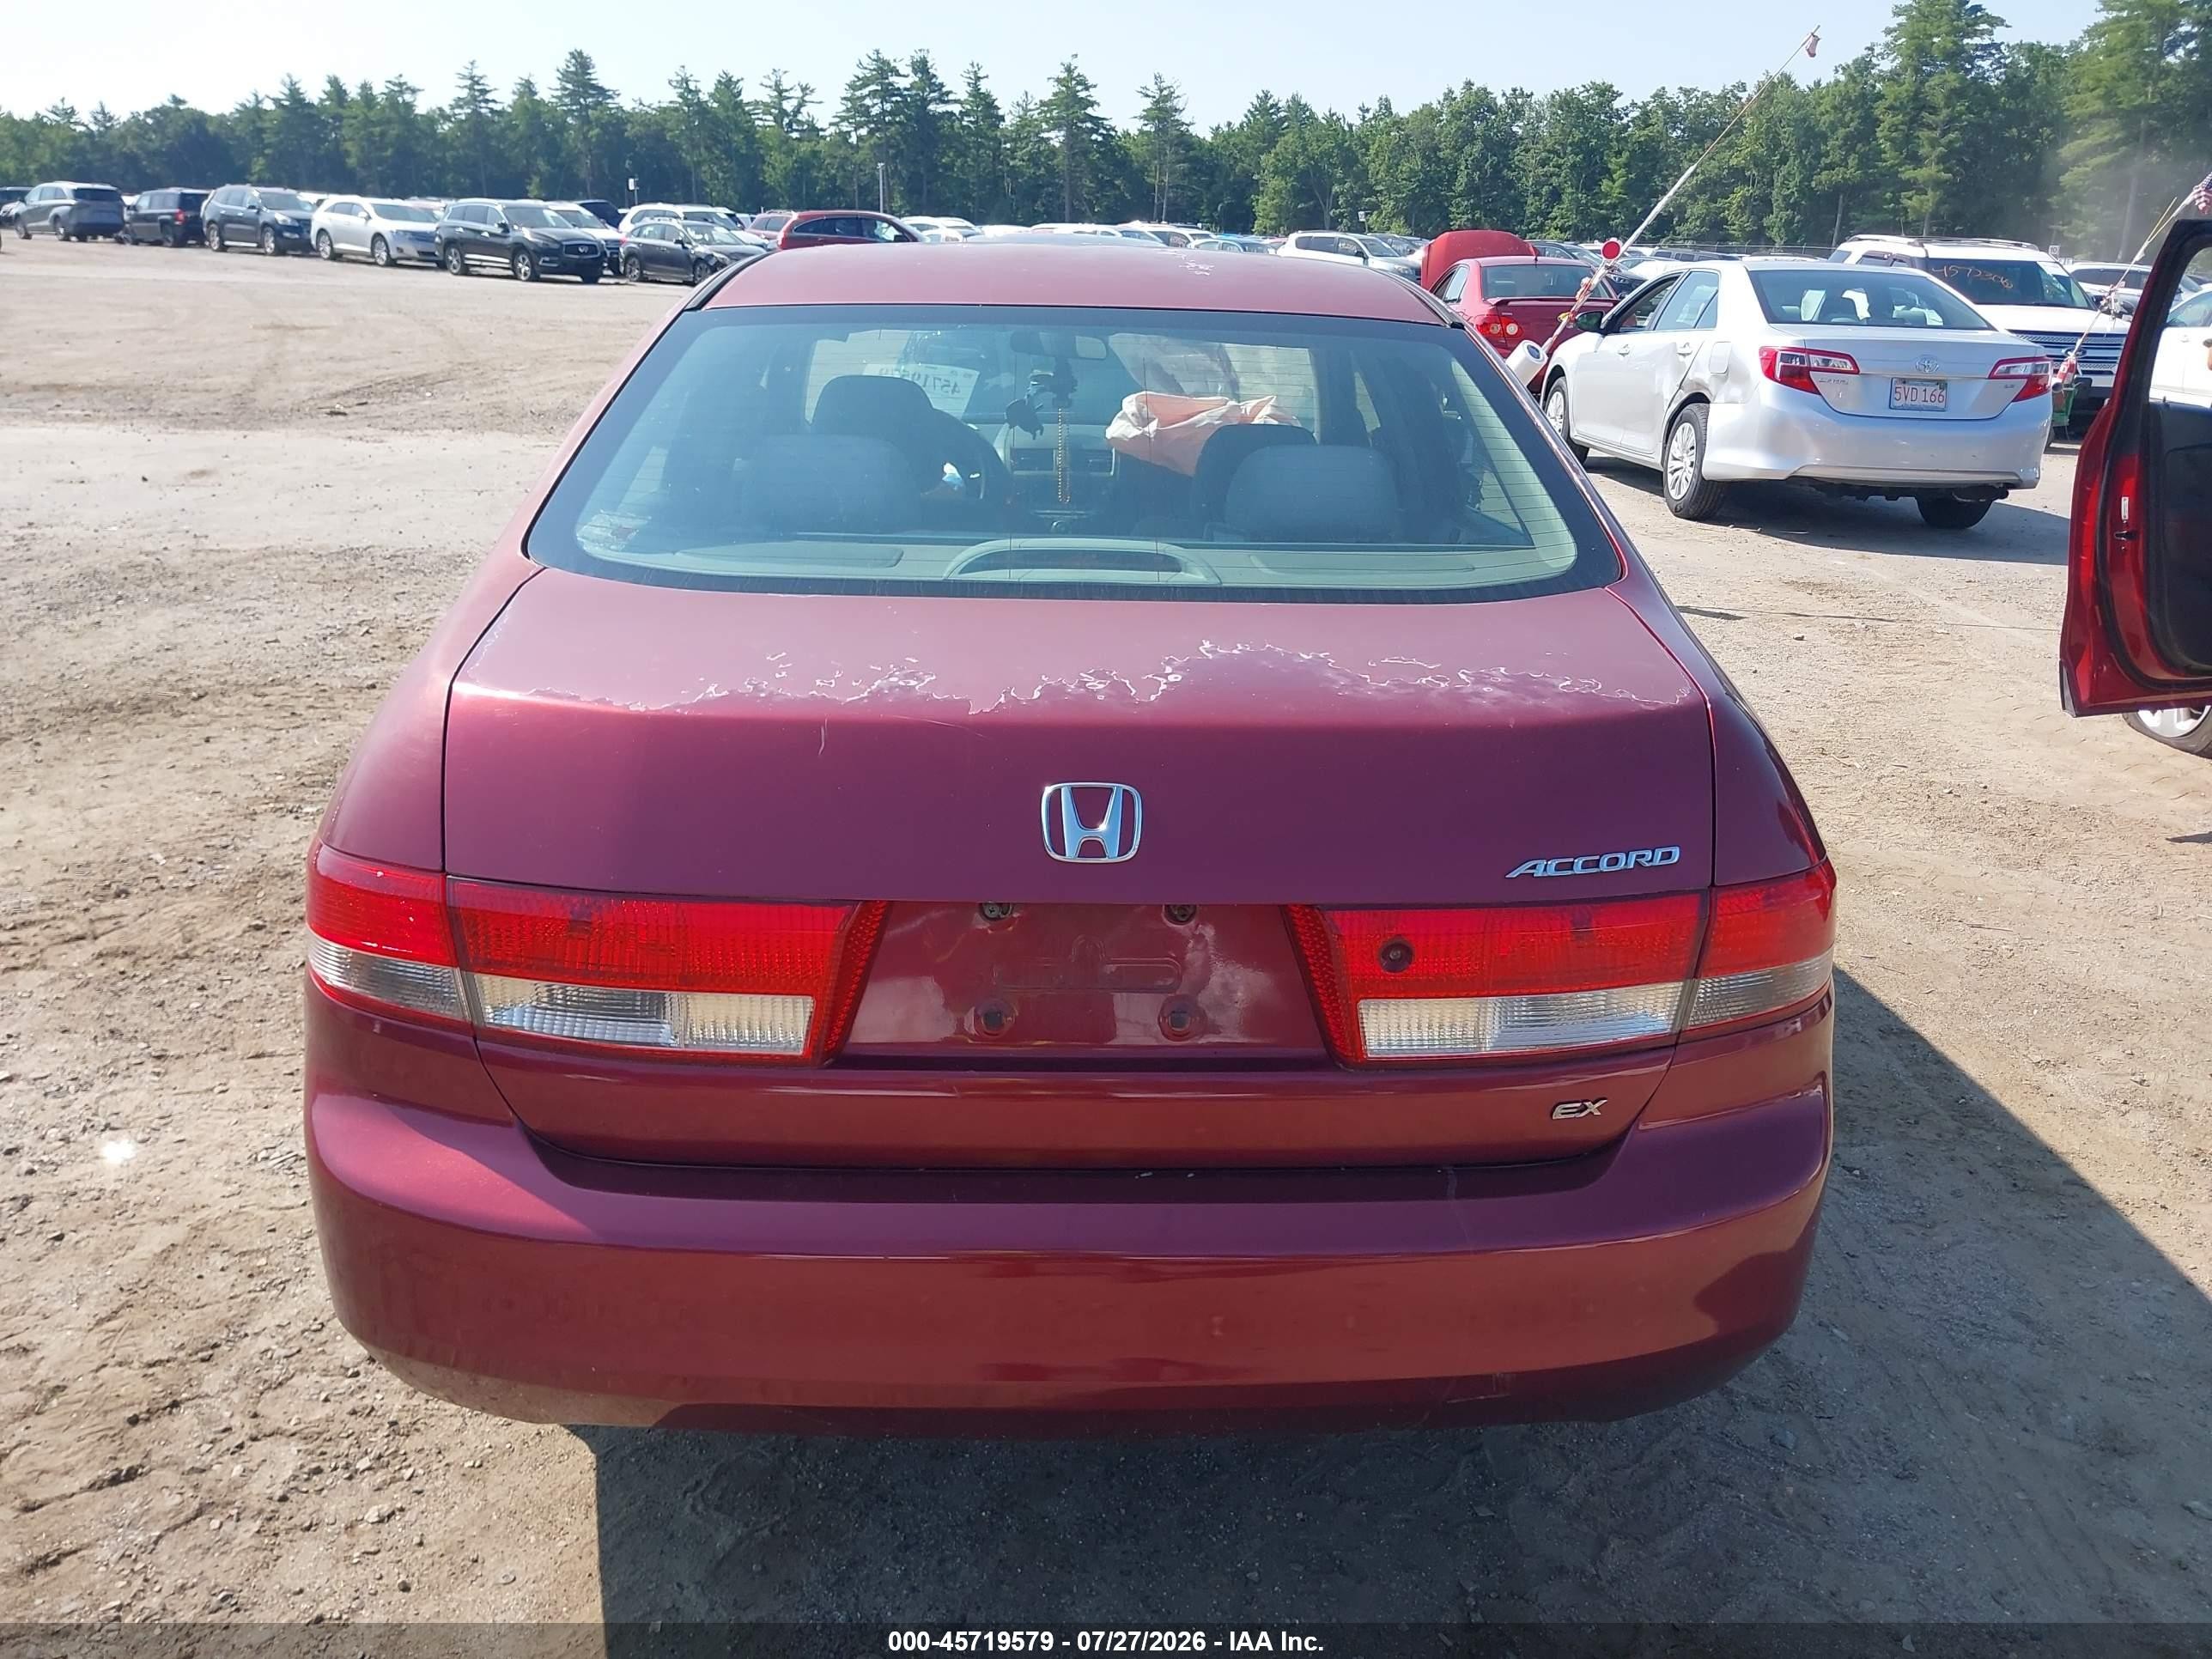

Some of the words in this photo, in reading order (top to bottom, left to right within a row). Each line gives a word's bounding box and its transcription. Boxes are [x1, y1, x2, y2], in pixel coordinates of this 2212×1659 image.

[1894, 386, 1918, 402] 5VD
[1922, 387, 1945, 404] 166
[1505, 845, 1680, 878] ACCORD
[1552, 1098, 1608, 1121] EX
